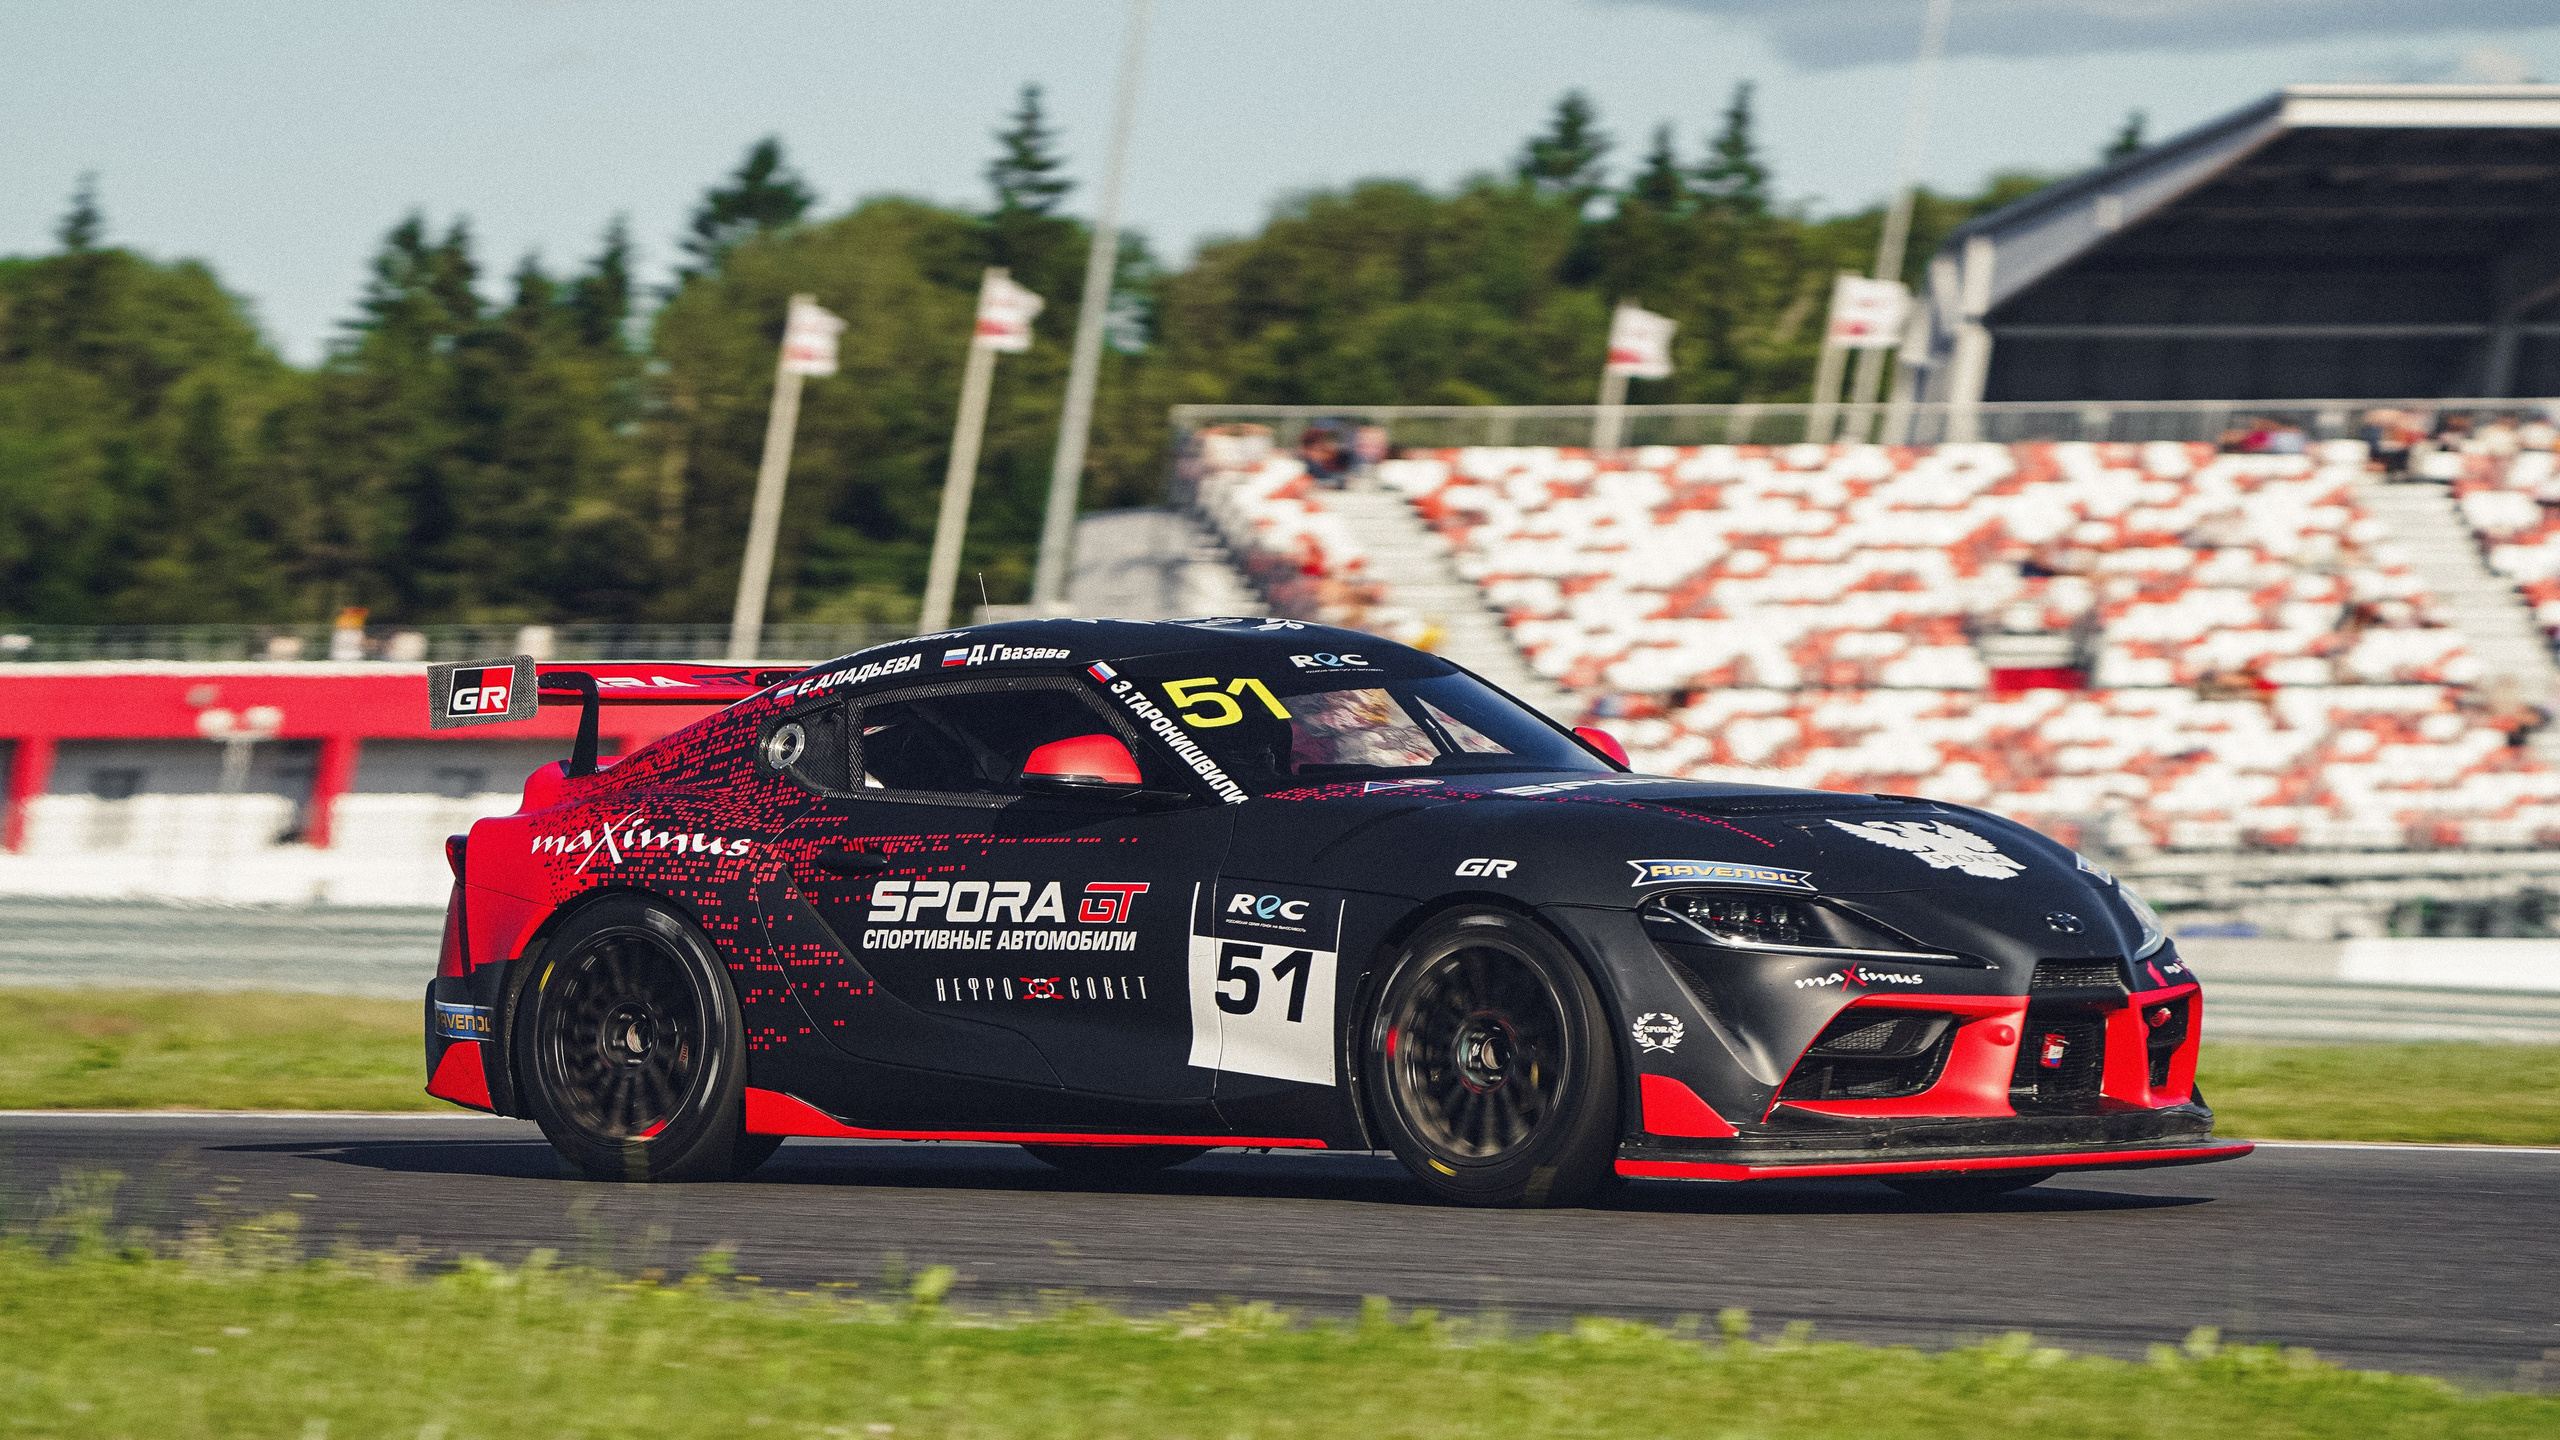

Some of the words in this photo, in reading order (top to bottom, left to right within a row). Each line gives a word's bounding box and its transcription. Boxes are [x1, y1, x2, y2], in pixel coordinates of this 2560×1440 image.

[966, 644, 1071, 666] Д.Гвазава
[797, 653, 922, 695] Е.АЛАДЬЕВА
[452, 686, 508, 712] GR
[1161, 677, 1292, 728] 51
[1455, 857, 1518, 879] GR
[1929, 854, 2009, 864] SPORA
[867, 881, 1066, 923] SPORA
[1077, 881, 1151, 924] GT
[863, 929, 992, 950] СПОРТИВНЫЕ
[996, 930, 1137, 951] АВТОМОБИЛИ
[936, 977, 1014, 1002] НЕФРО
[1069, 976, 1148, 1000] СОВЕТ
[1215, 941, 1314, 1023] 51
[1644, 1025, 1674, 1034] SPORA
